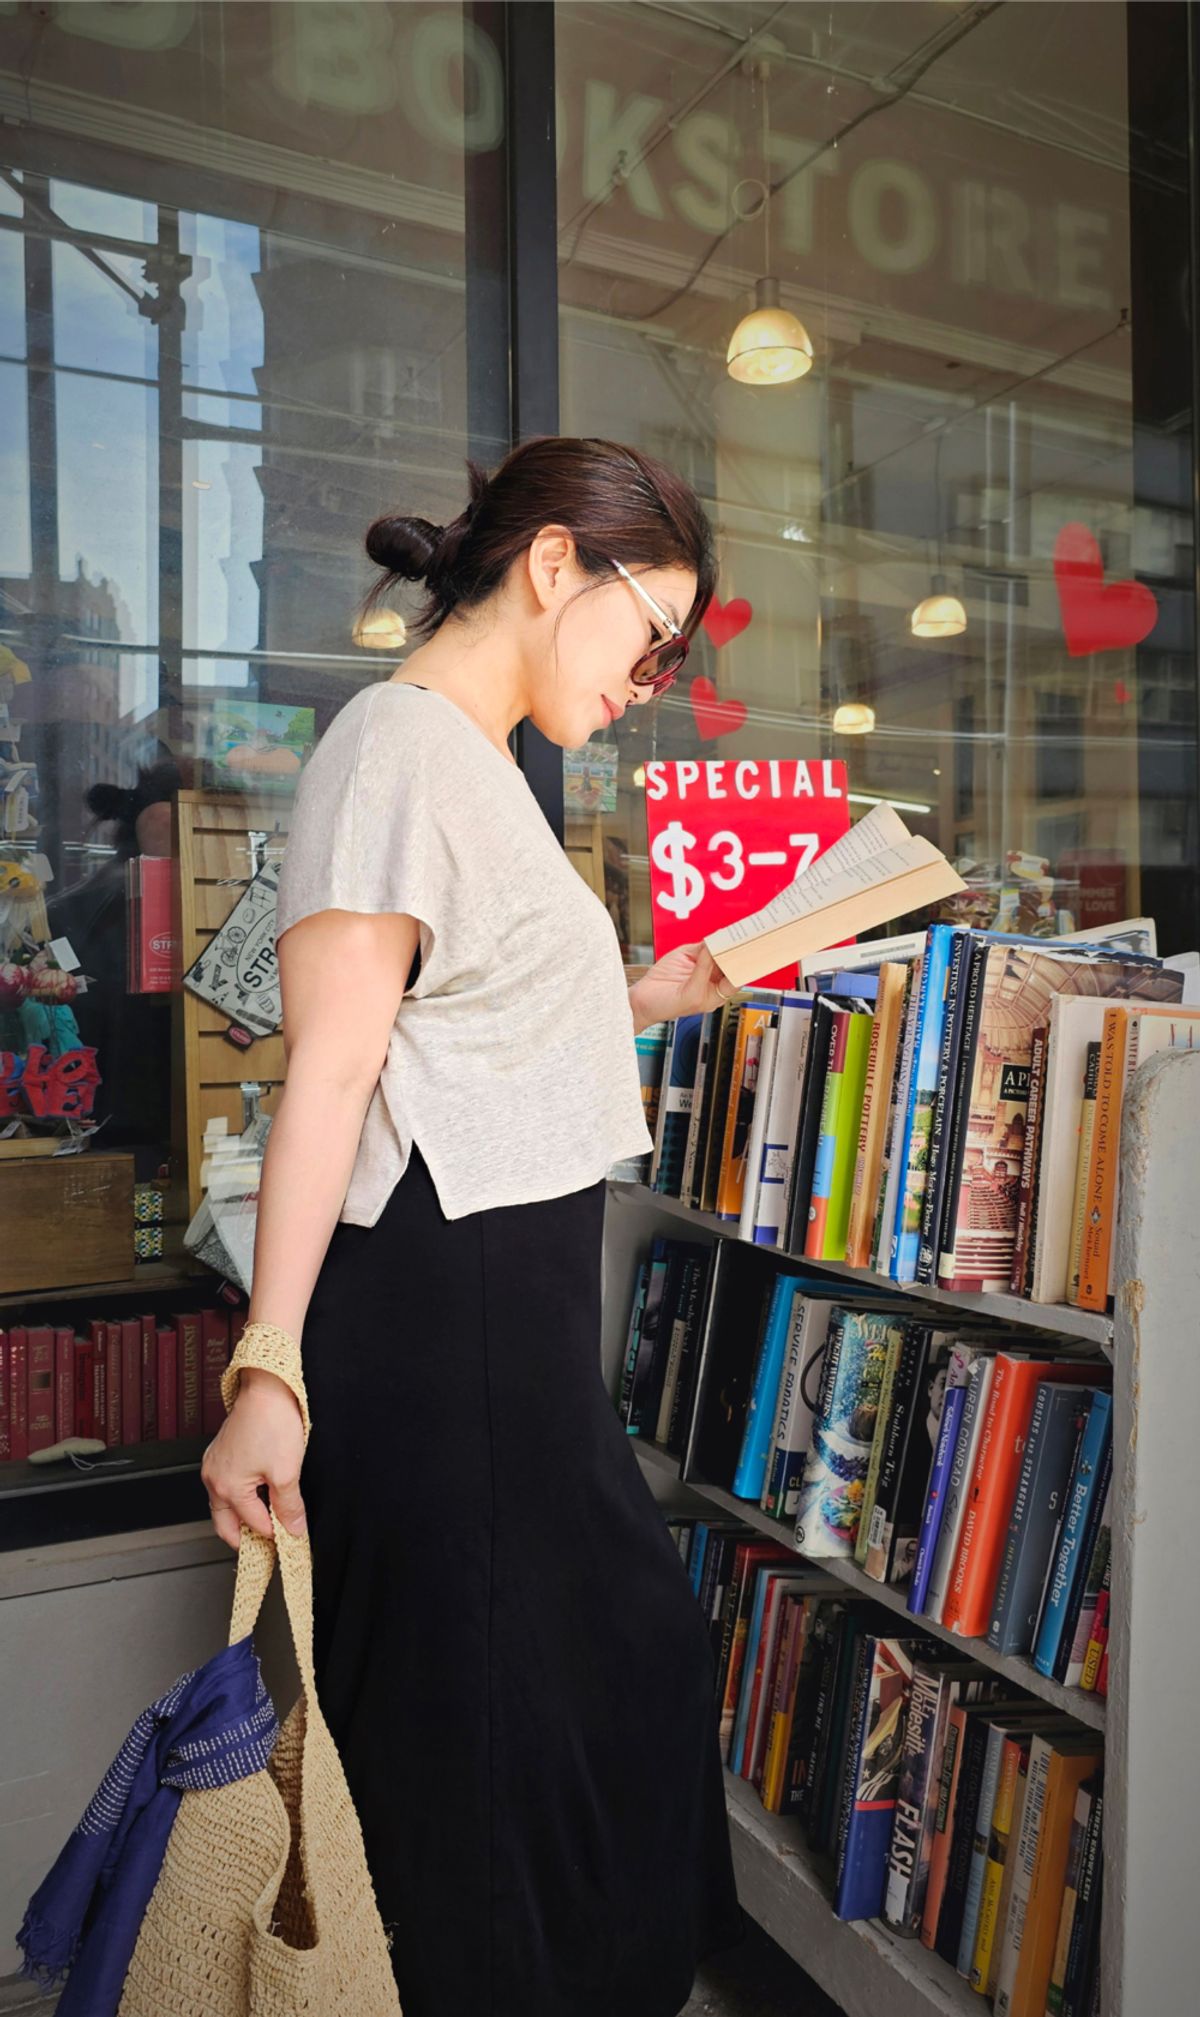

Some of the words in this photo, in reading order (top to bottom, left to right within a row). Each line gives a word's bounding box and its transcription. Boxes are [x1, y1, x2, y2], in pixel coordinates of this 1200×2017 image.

[646, 760, 842, 800] SPECIAL
[253, 930, 267, 947] YORK
[974, 952, 981, 960] A
[243, 936, 279, 988] STR
[948, 938, 962, 995] INVESTING
[968, 961, 980, 998] PROUD
[907, 991, 918, 1016] THE
[946, 998, 955, 1010] IN
[828, 1024, 837, 1056] OVER
[902, 1017, 915, 1057] YOUNG
[941, 1013, 954, 1062] POTTERY
[962, 999, 975, 1051] HERITAGE
[1105, 1022, 1117, 1049] WAS
[865, 1022, 880, 1092] ROSEVILLE
[939, 1063, 948, 1072] &
[1031, 1038, 1044, 1076] ADULT
[1085, 1053, 1095, 1091] CAHILL
[1101, 1054, 1114, 1089] TOLD
[895, 1058, 909, 1104] DANCER
[1004, 1072, 1017, 1086] A
[933, 1074, 947, 1135] PORCELAIN
[1026, 1078, 1040, 1123] CAREER
[1100, 1092, 1111, 1113] TO
[857, 1094, 871, 1152] POTTERY
[1096, 1113, 1109, 1153] COME
[928, 1143, 940, 1167] Hugo
[1020, 1124, 1036, 1189] PATHWAYS
[1081, 1154, 1089, 1172] THE
[1092, 1156, 1106, 1201] ALONE
[1092, 1226, 1102, 1256] Souad
[786, 1304, 807, 1365] SERVICE
[828, 1326, 845, 1366] WEIGHT
[819, 1366, 838, 1418] WATCHERS
[992, 1368, 1005, 1389] The
[775, 1371, 795, 1439] FANATICS
[985, 1416, 995, 1427] to
[988, 1390, 1000, 1414] Road
[1030, 1388, 1046, 1433] COUSINS
[884, 1402, 906, 1457] Stubborn
[935, 1432, 949, 1467] Notebook
[879, 1458, 896, 1488] Twig
[950, 1426, 970, 1487] CONRAD
[975, 1429, 992, 1480] Character
[1013, 1456, 1033, 1520] STRANGERS
[1066, 1482, 1087, 1534] Better
[962, 1510, 977, 1545] DAVID
[953, 1546, 969, 1594] BROOKS
[1049, 1534, 1077, 1608] Together
[1082, 1648, 1099, 1685] USED
[813, 1715, 823, 1730] ME
[815, 1691, 826, 1714] FIND
[903, 1671, 940, 1753] Modesitt
[1031, 1779, 1047, 1813] HONOR
[1091, 1796, 1103, 1838] FATHER
[886, 1797, 919, 1884] FLASH
[1022, 1825, 1040, 1877] NEGOTIATE
[1085, 1838, 1097, 1875] KNOWS
[1082, 1876, 1092, 1904] LESS
